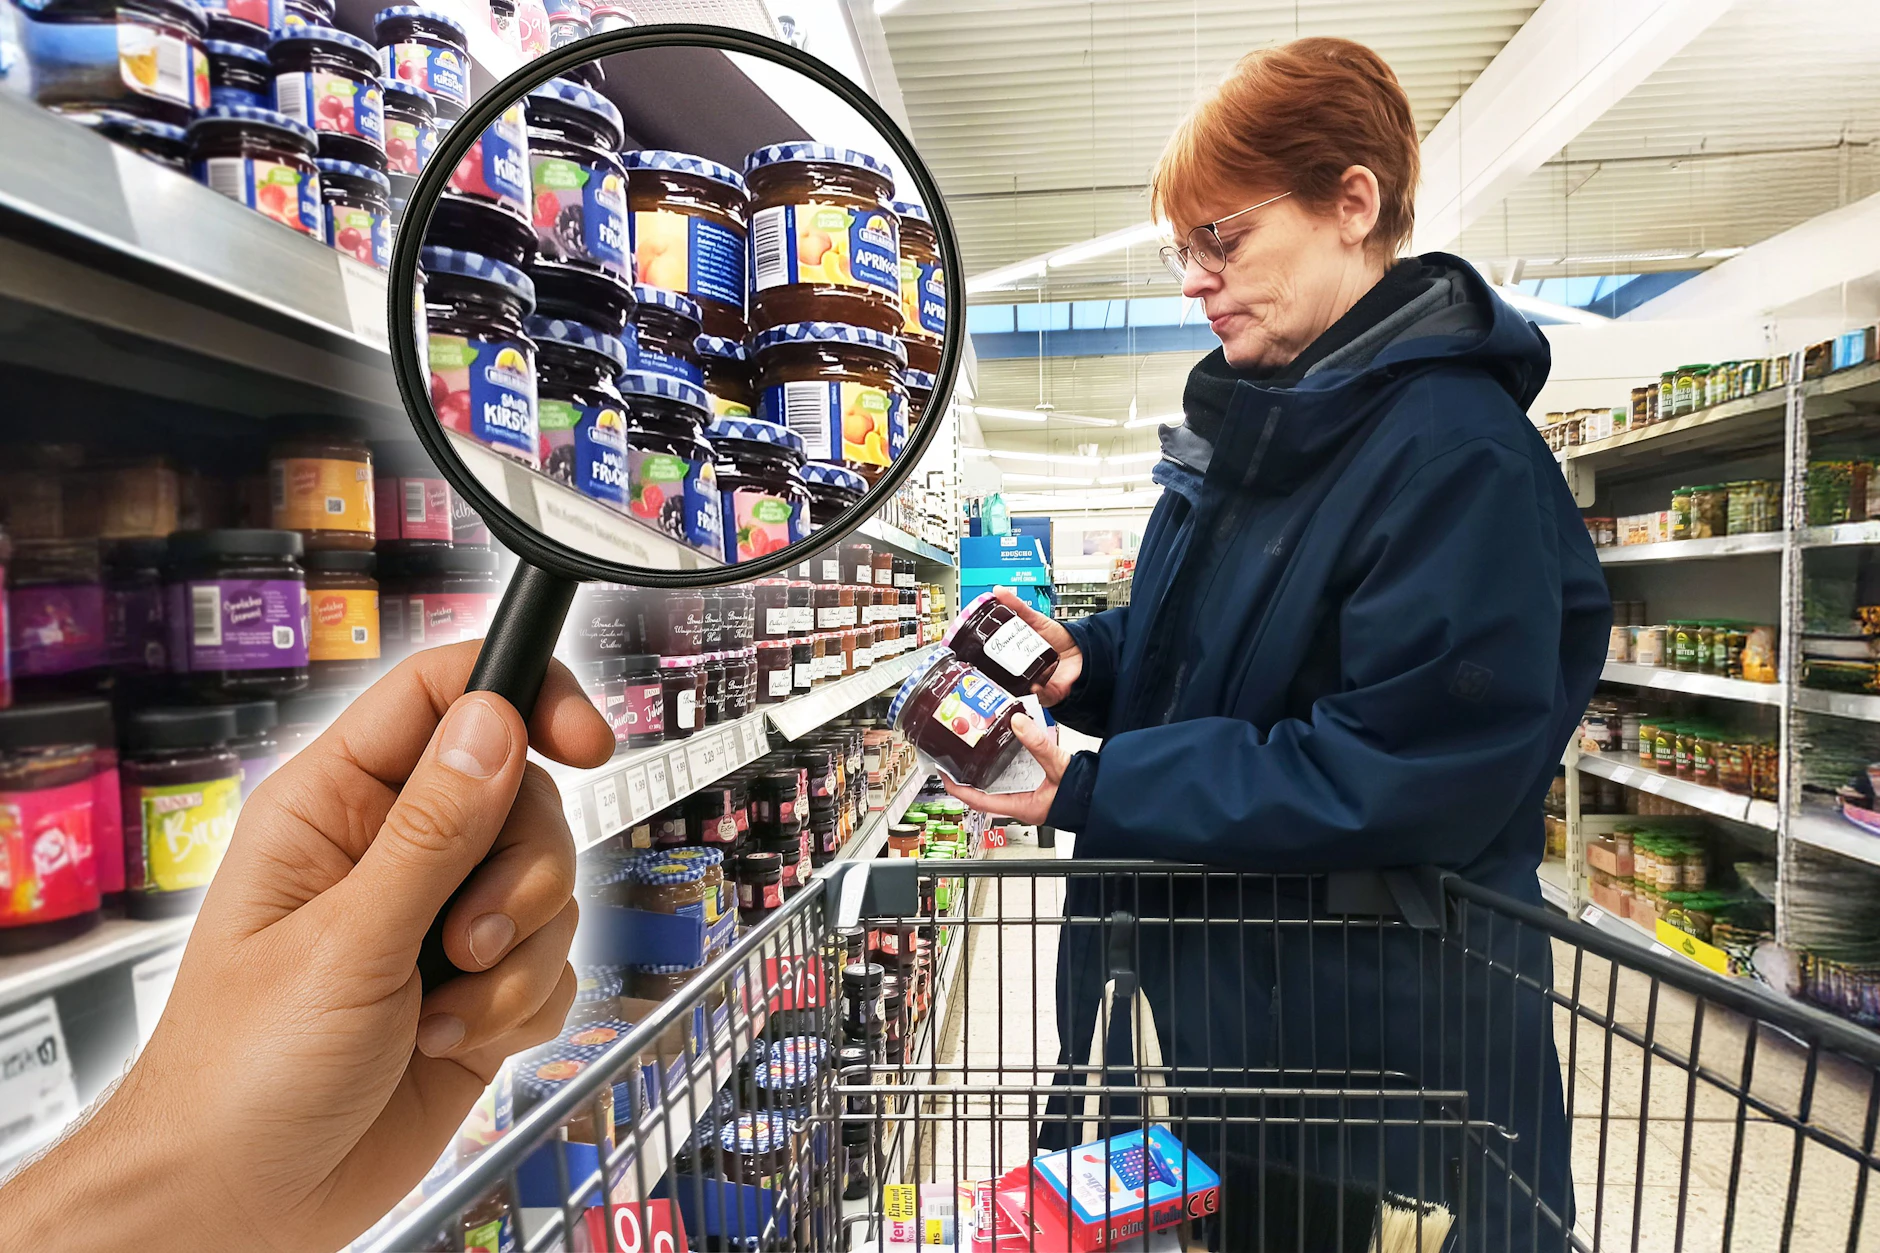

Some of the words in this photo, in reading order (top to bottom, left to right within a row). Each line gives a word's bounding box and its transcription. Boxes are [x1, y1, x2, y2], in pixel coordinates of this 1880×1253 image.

[1001, 550, 1033, 558] EDUSCHO
[703, 750, 715, 765] 3,29
[676, 761, 686, 773] 1,99
[654, 770, 665, 783] 1,99
[634, 779, 646, 793] 1,99
[604, 792, 616, 807] 2,09
[901, 1187, 913, 1216] durch!
[1187, 1189, 1215, 1218] CE
[888, 1202, 901, 1218] Ein
